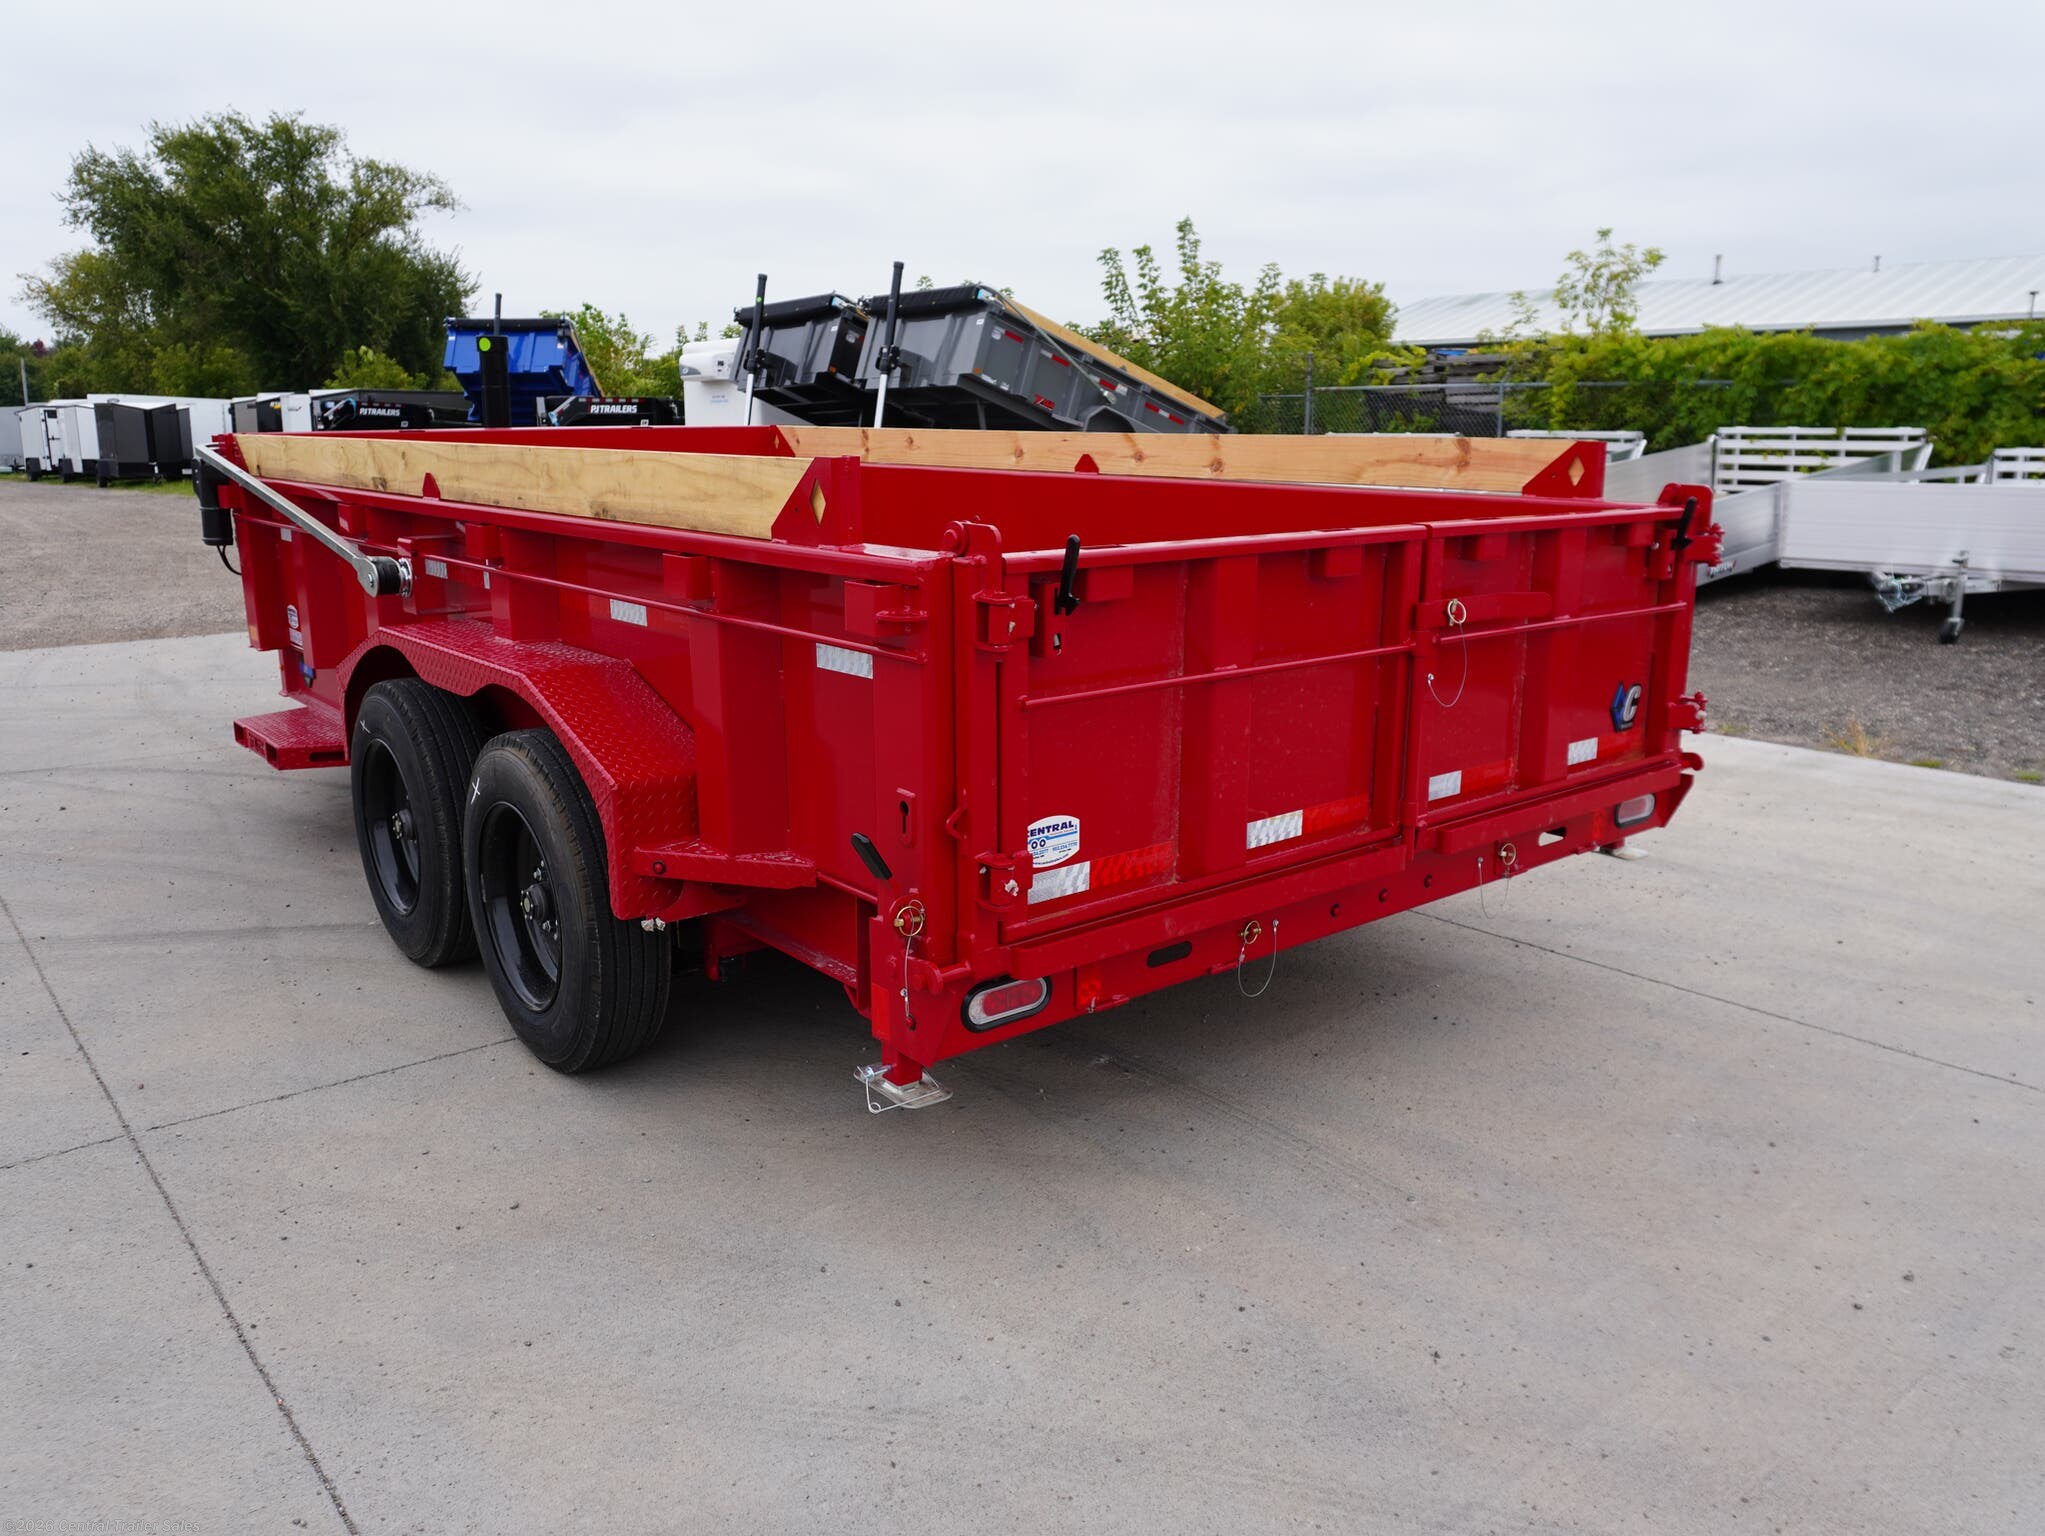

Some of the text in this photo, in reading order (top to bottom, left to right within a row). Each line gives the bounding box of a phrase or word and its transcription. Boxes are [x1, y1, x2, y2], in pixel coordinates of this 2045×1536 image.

[368, 408, 400, 416] TRAILERS
[600, 405, 637, 413] TRAILERS
[1028, 821, 1074, 837] ENTRAL
